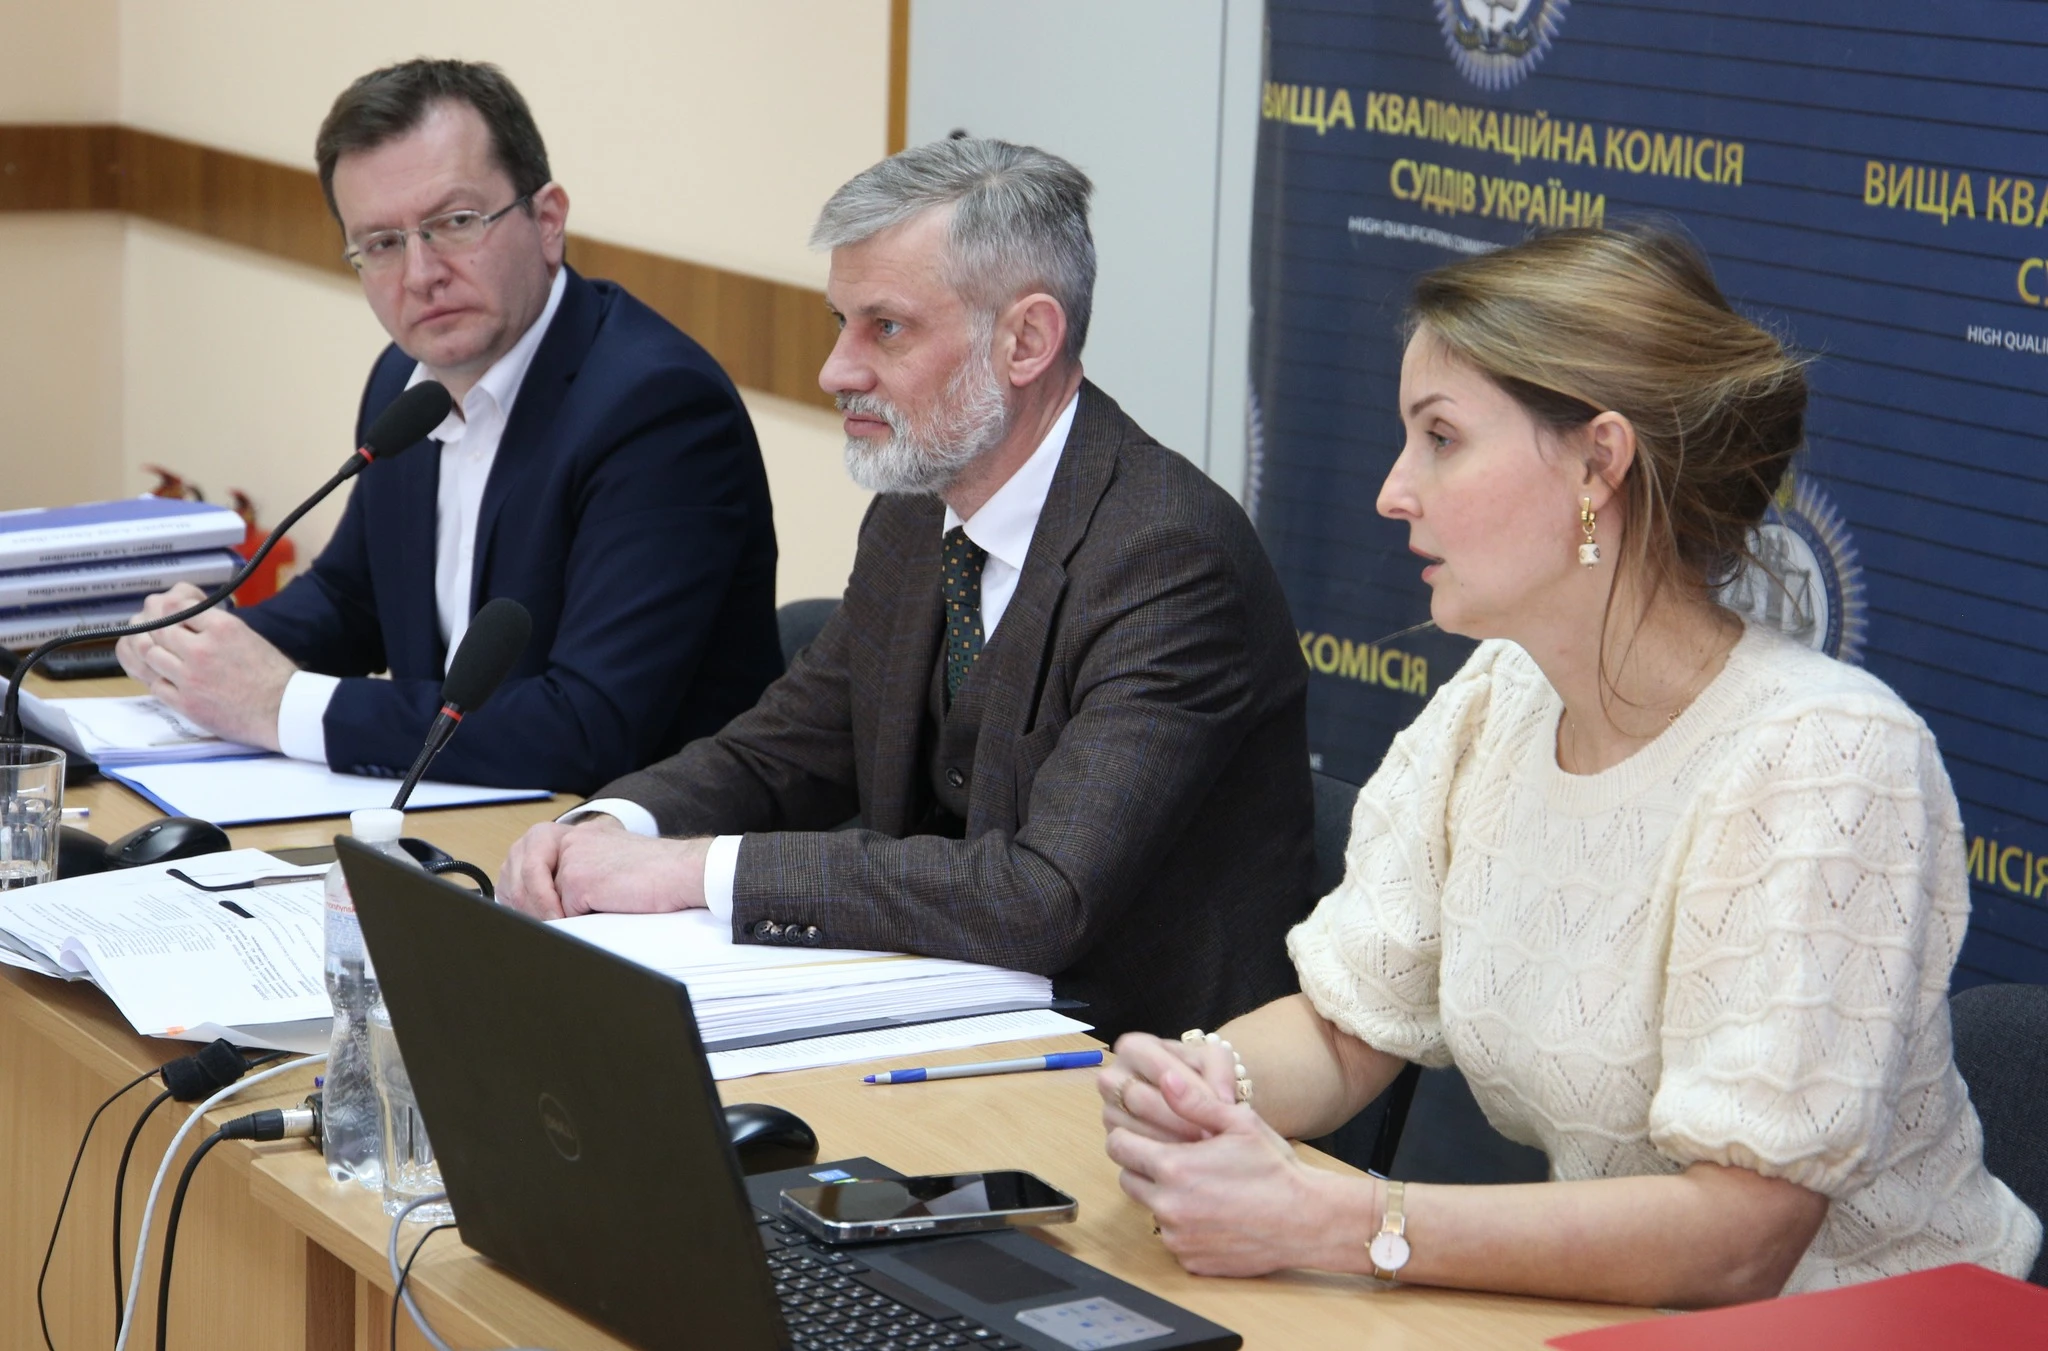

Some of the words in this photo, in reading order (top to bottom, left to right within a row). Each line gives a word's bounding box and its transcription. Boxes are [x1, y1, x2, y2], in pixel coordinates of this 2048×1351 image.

[1262, 81, 1355, 135] ВИЩА
[1366, 91, 1597, 167] КВАЛІФІКАЦІЙНА
[1604, 126, 1745, 187] КОМІСІЯ
[1390, 158, 1477, 216] СУДДІВ
[1480, 175, 1605, 229] УКРАЇНИ
[1864, 160, 1976, 226] ВИЩА
[1967, 325, 2002, 347] HIGH
